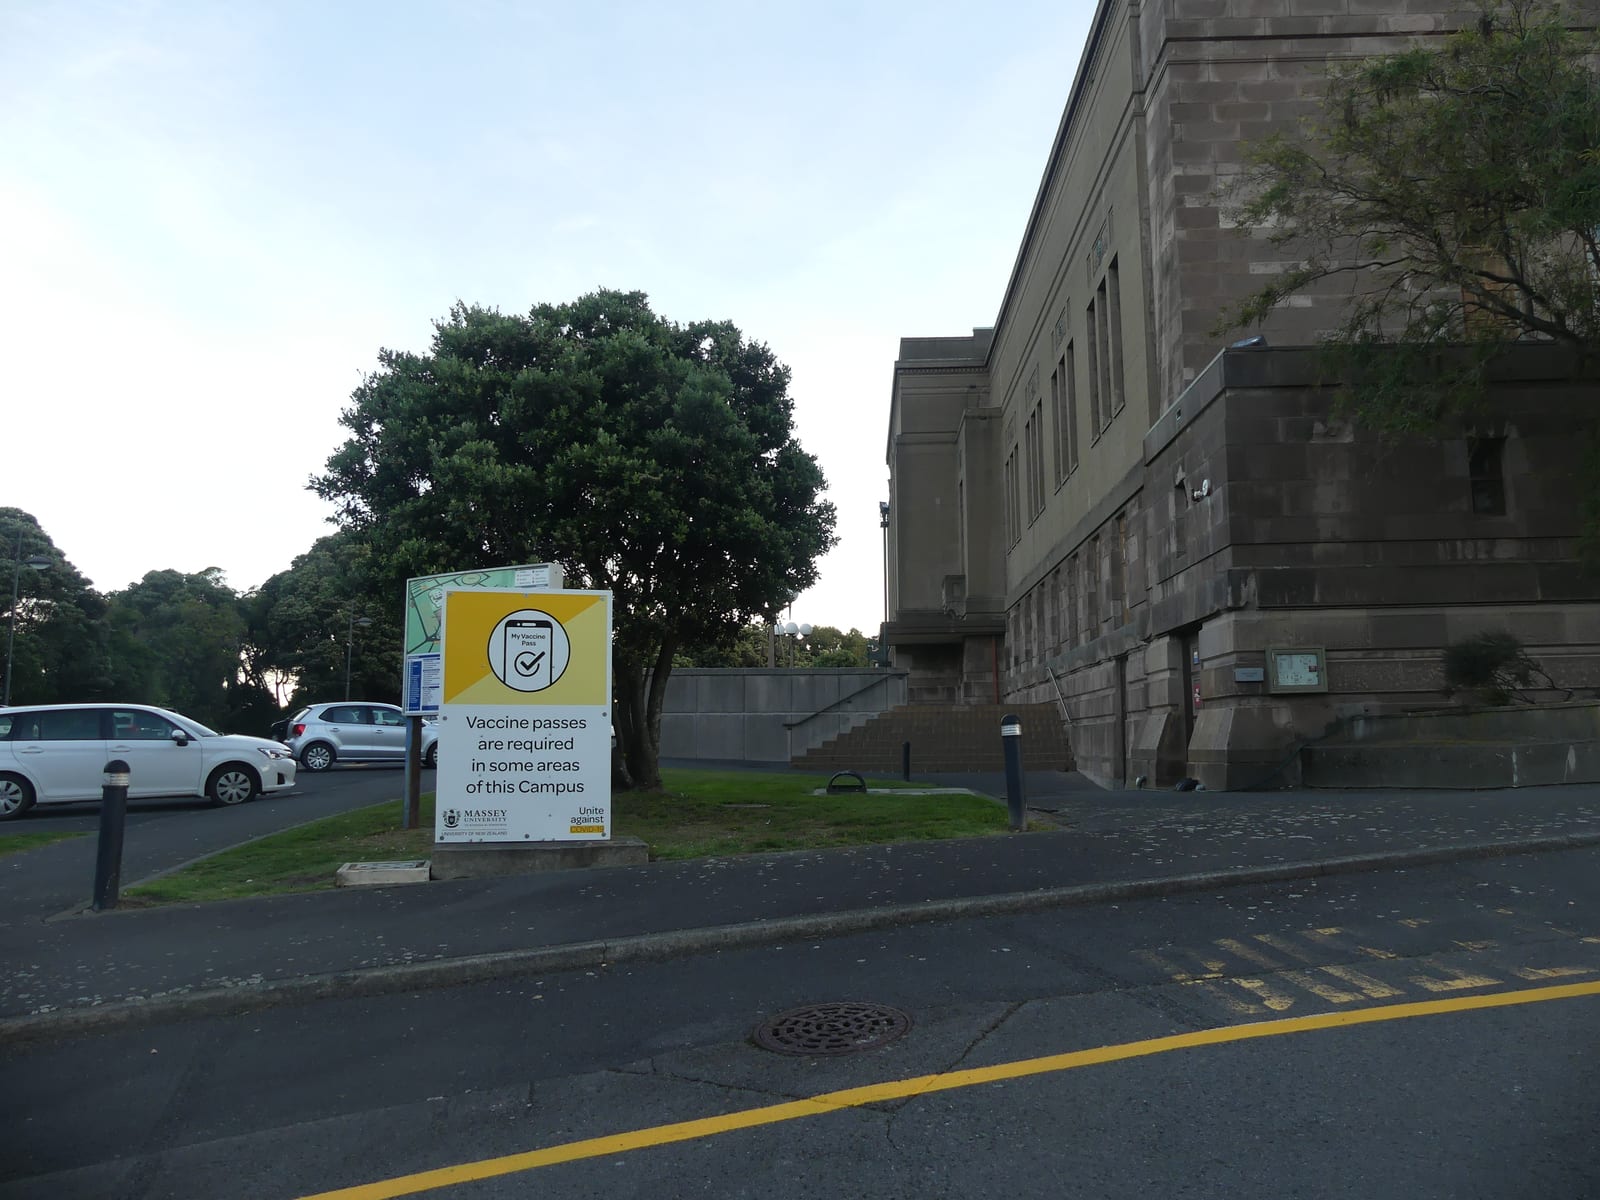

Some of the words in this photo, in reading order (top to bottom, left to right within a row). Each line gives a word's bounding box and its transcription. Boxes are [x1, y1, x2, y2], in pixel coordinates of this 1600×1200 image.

[466, 715, 529, 729] Vaccine
[532, 718, 587, 732] passes
[478, 740, 504, 750] are
[507, 737, 574, 753] required
[471, 758, 486, 772] in
[489, 761, 534, 772] some
[537, 761, 580, 772] areas
[466, 780, 484, 794] of
[485, 780, 515, 794] this
[518, 780, 585, 796] Campus
[464, 809, 508, 817] MASSEY
[579, 806, 604, 815] Unite
[570, 815, 604, 825] against
